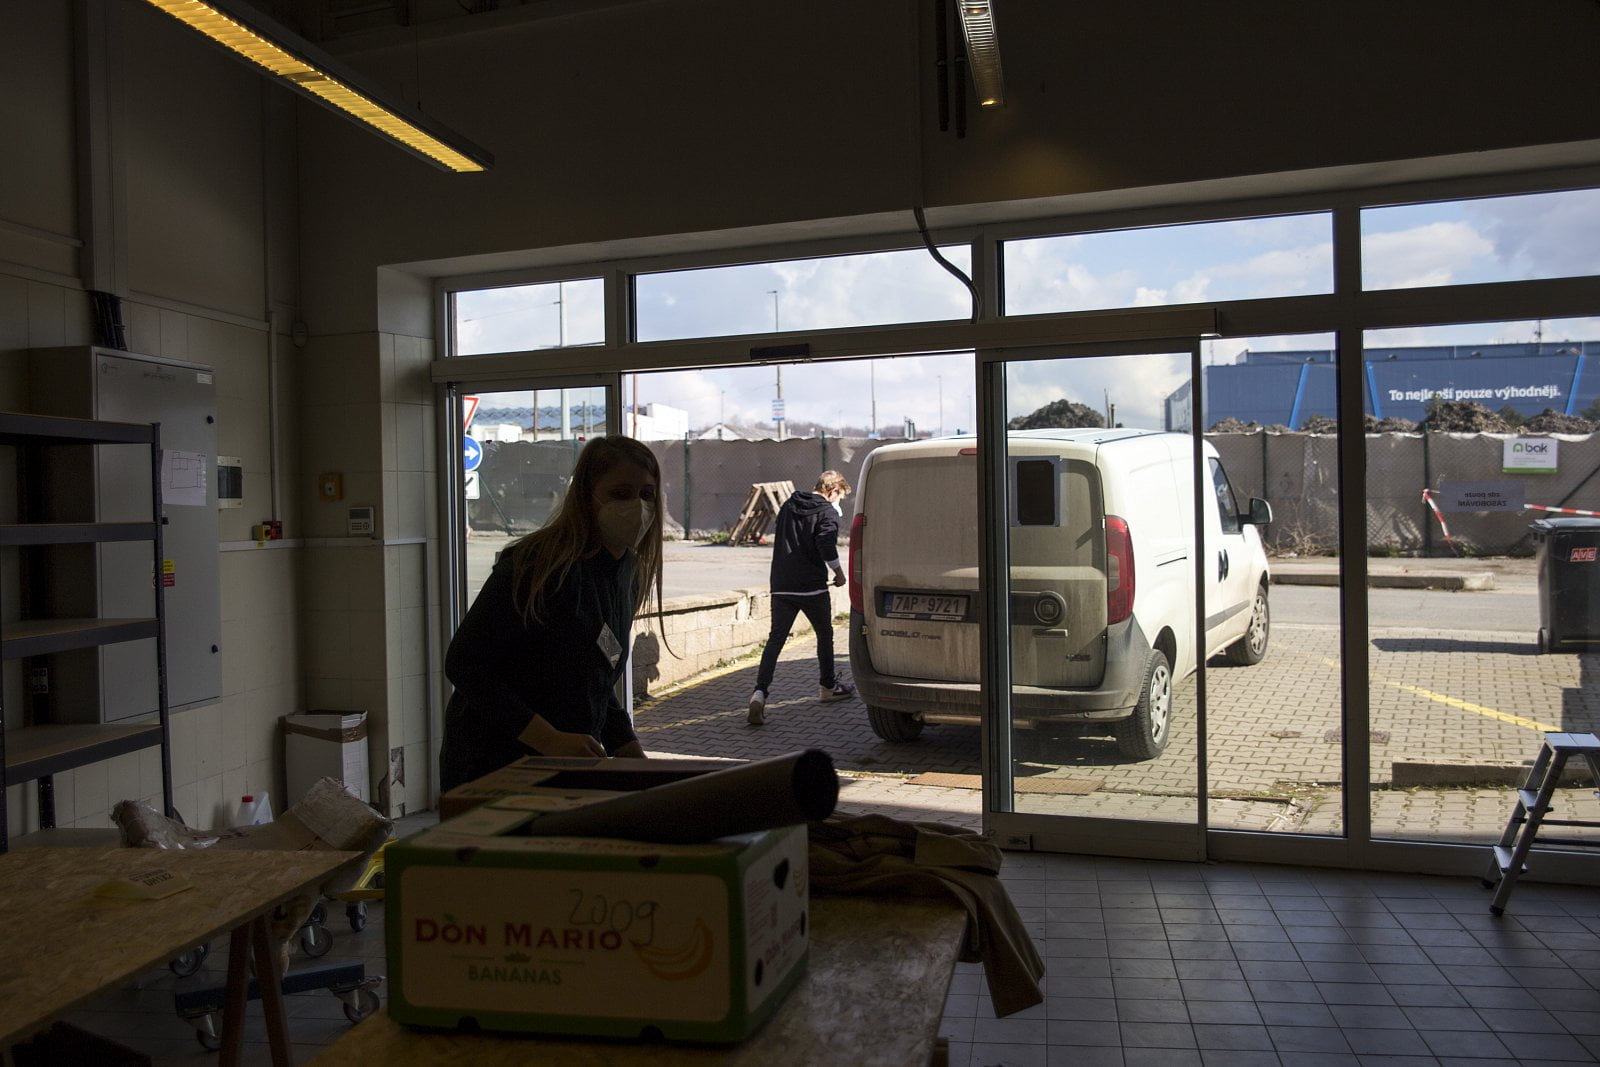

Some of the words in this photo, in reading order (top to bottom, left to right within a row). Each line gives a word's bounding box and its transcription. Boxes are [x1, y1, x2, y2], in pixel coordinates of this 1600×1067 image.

[1389, 390, 1404, 401] To
[1455, 389, 1493, 401] pouze
[1525, 442, 1548, 453] bak
[1572, 550, 1595, 560] AVE
[895, 596, 919, 611] 7AP
[927, 598, 960, 613] 9721
[415, 919, 488, 946] DON
[504, 922, 623, 951] MARIO
[467, 965, 562, 985] BANANAS
